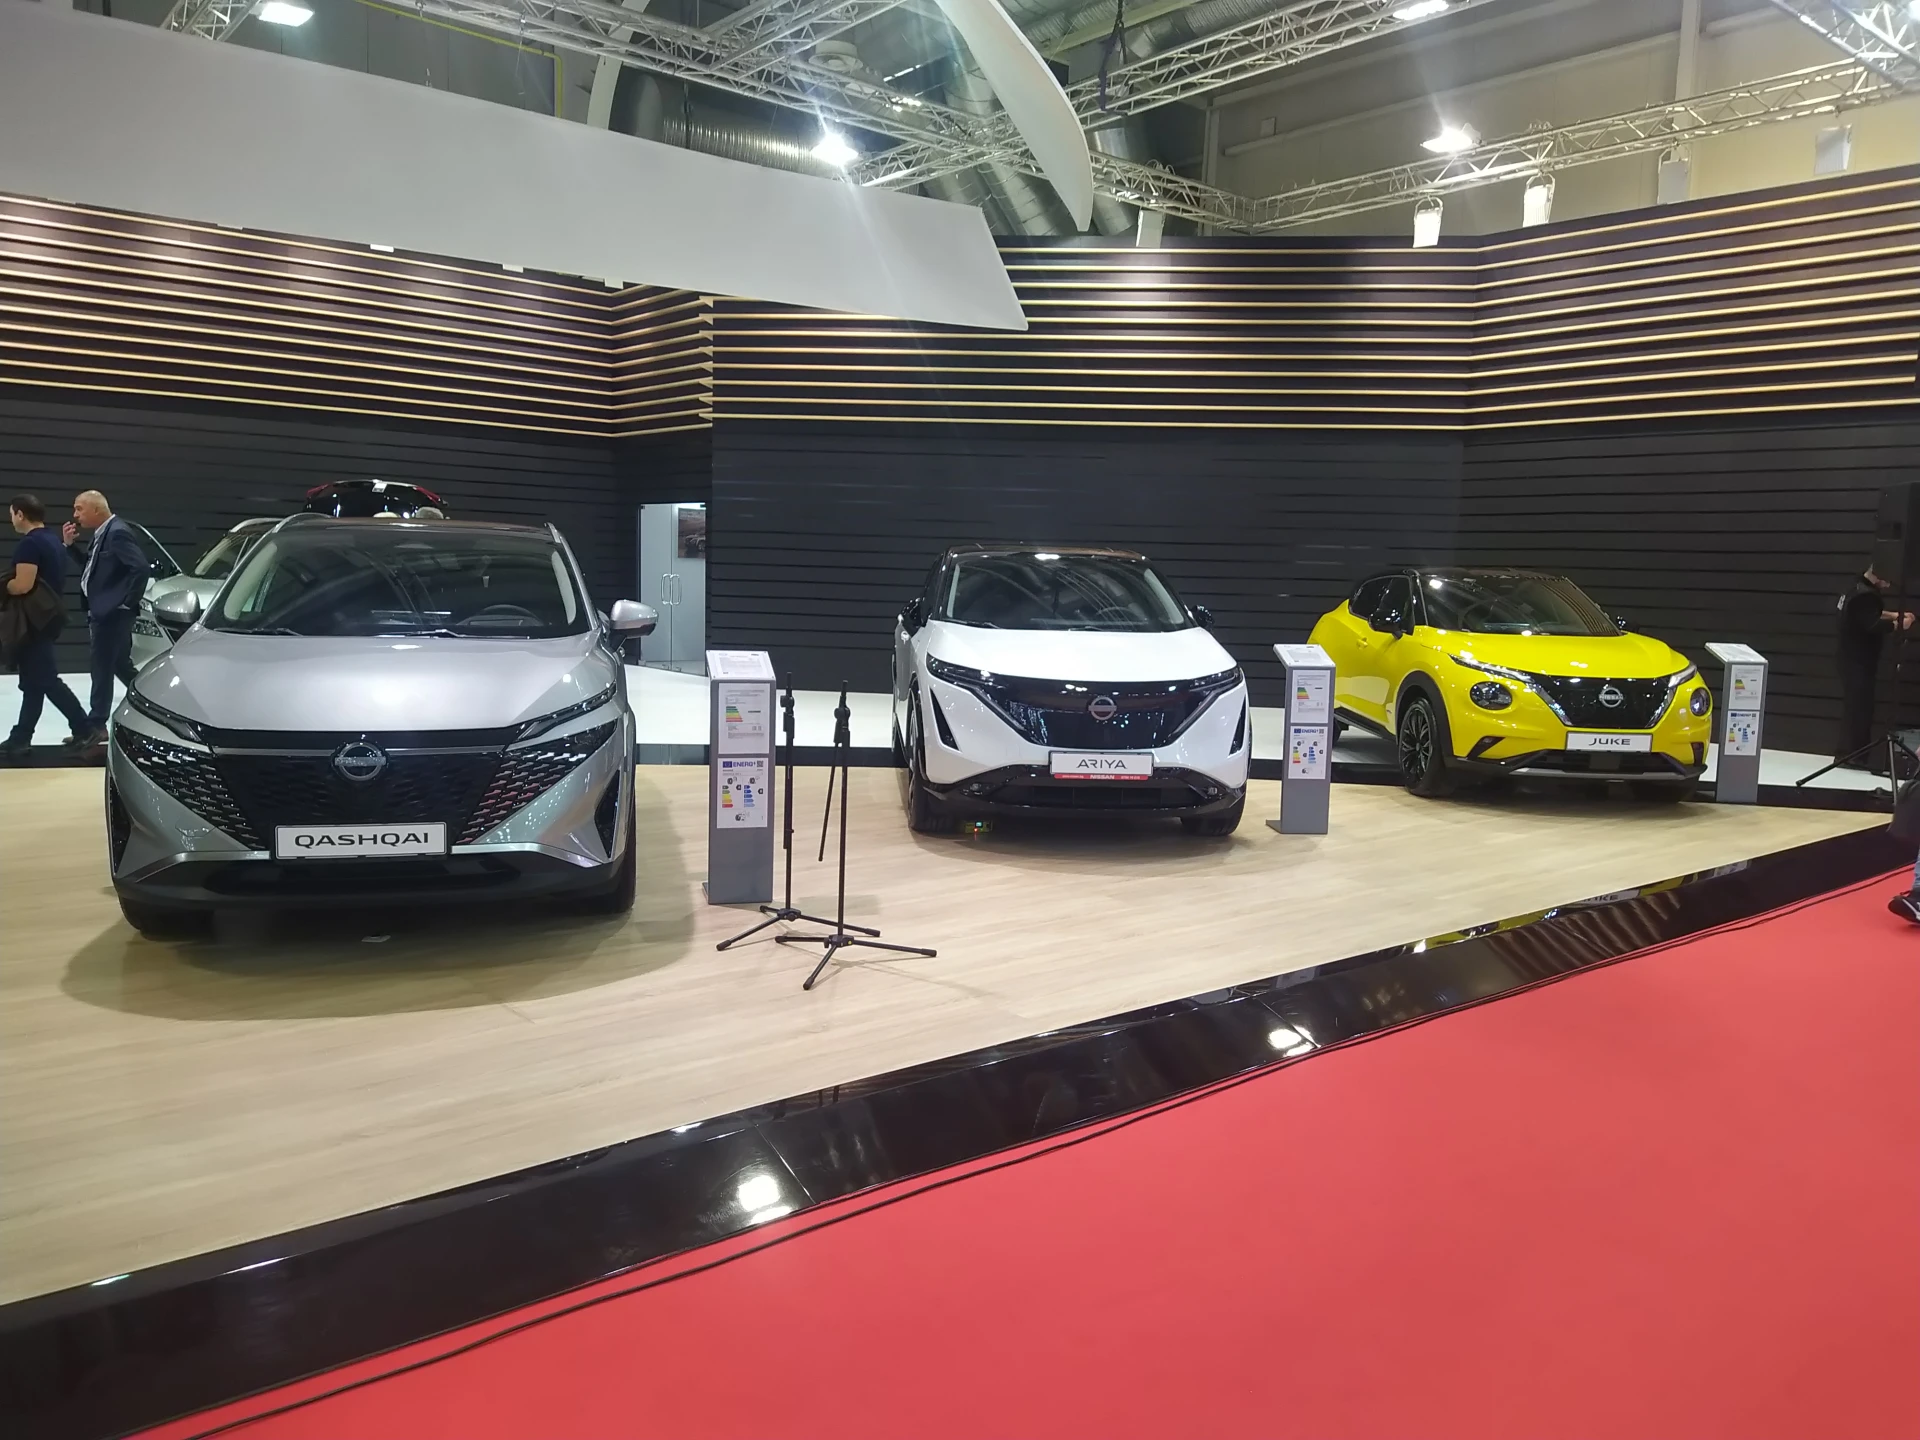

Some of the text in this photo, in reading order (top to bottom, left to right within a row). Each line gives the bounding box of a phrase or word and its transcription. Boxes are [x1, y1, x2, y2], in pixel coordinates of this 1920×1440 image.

[1589, 738, 1631, 746] JUKE
[1076, 759, 1127, 769] ARIYA
[294, 832, 429, 849] QASHQAI
